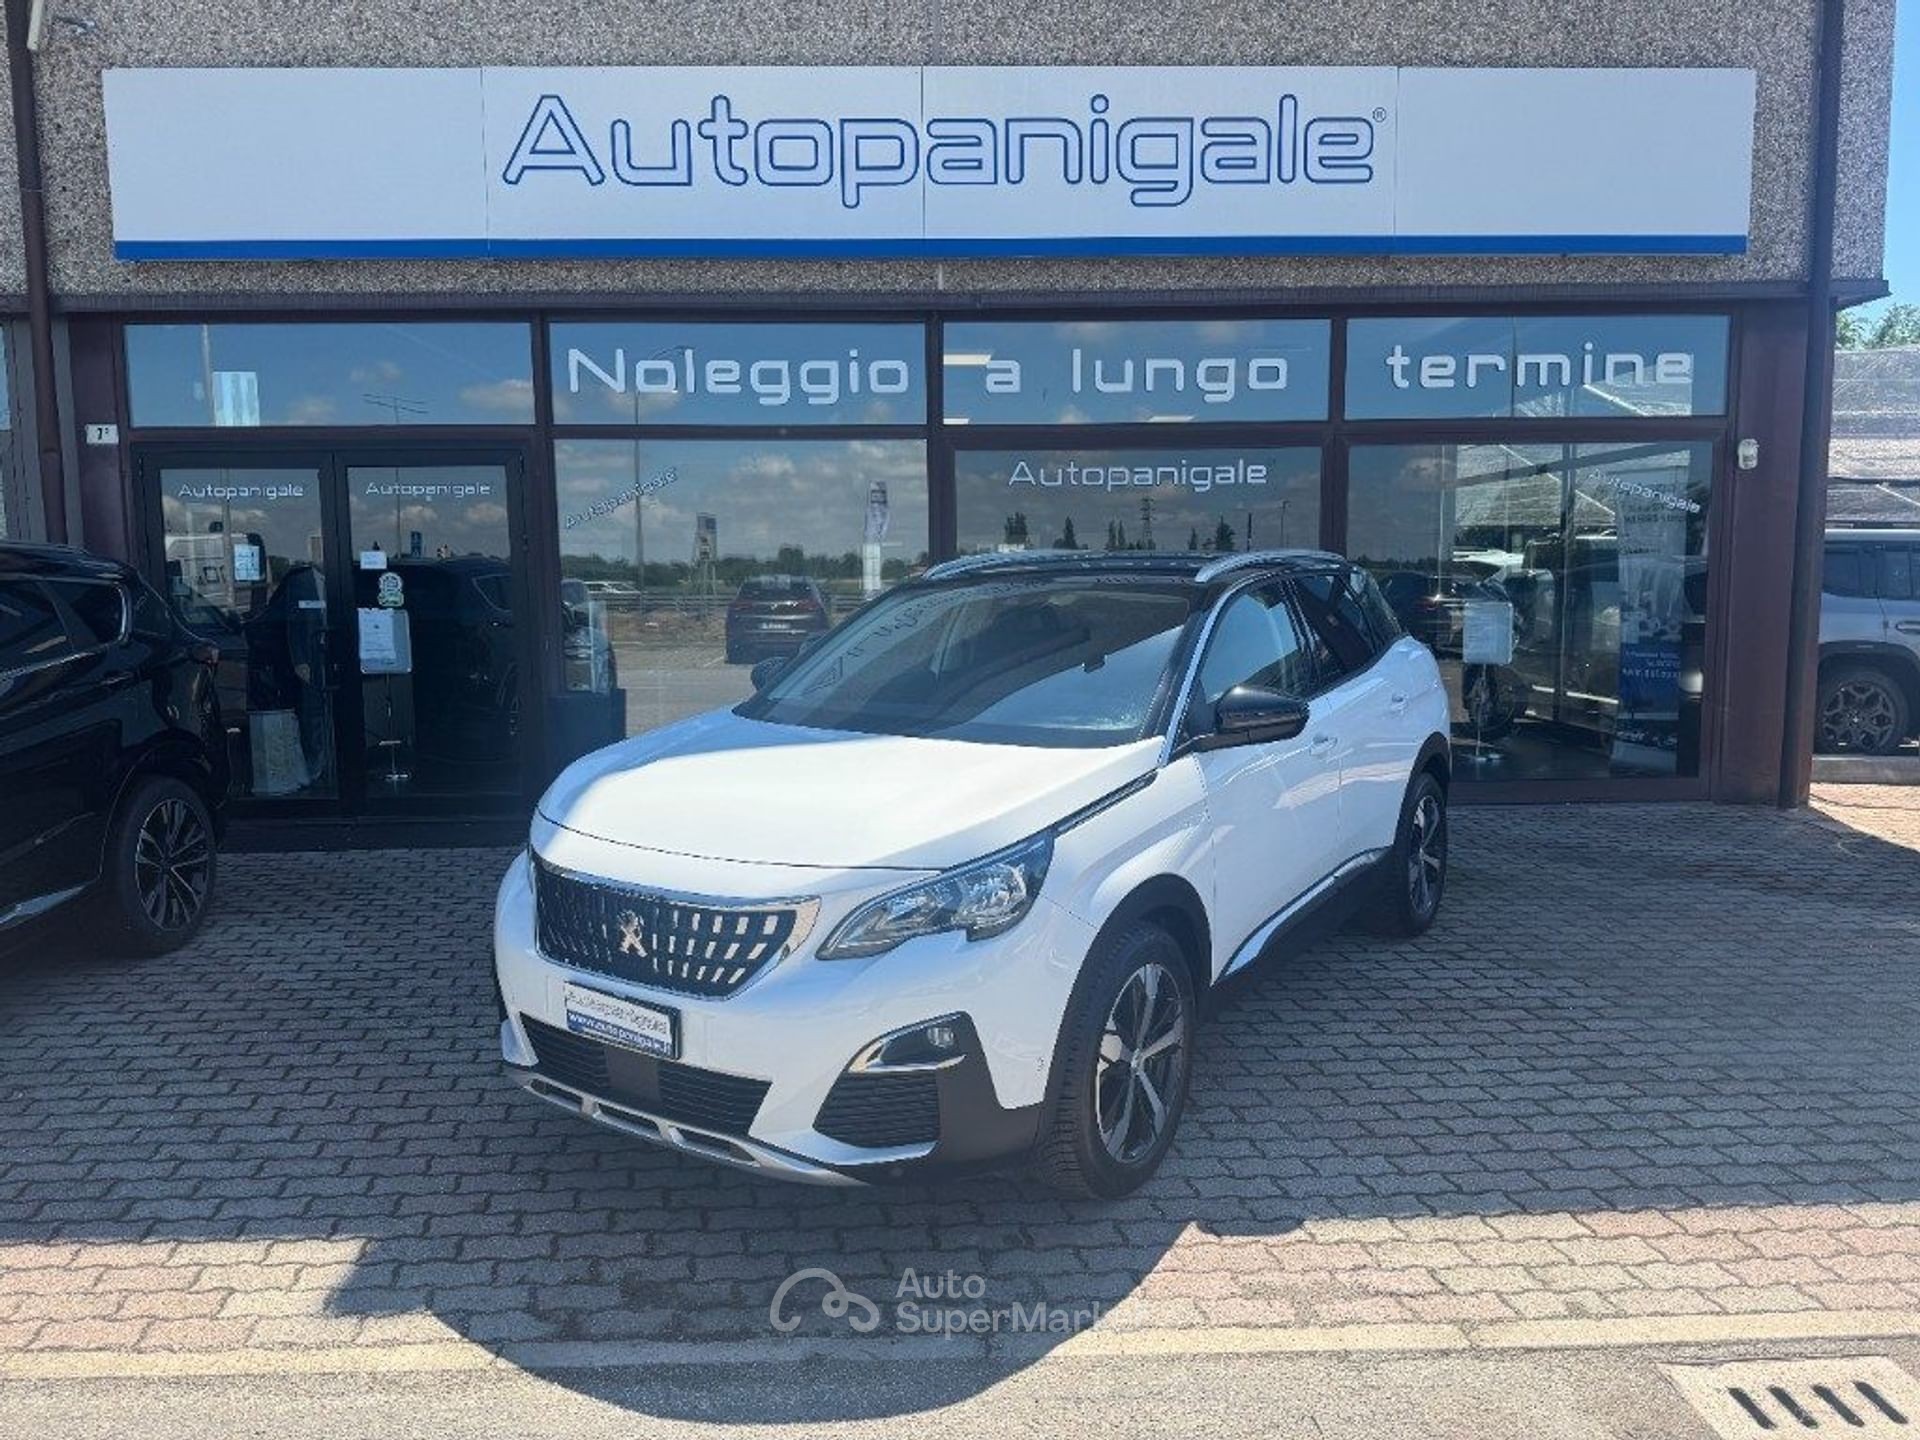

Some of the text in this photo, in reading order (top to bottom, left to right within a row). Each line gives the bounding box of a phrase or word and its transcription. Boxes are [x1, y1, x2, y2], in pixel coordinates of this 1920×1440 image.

[567, 341, 1695, 406] Noleggio a lungo termine
[365, 480, 491, 498] Autopanigale
[1007, 458, 1268, 493] Autopanigale
[178, 481, 304, 500] Autopanigale
